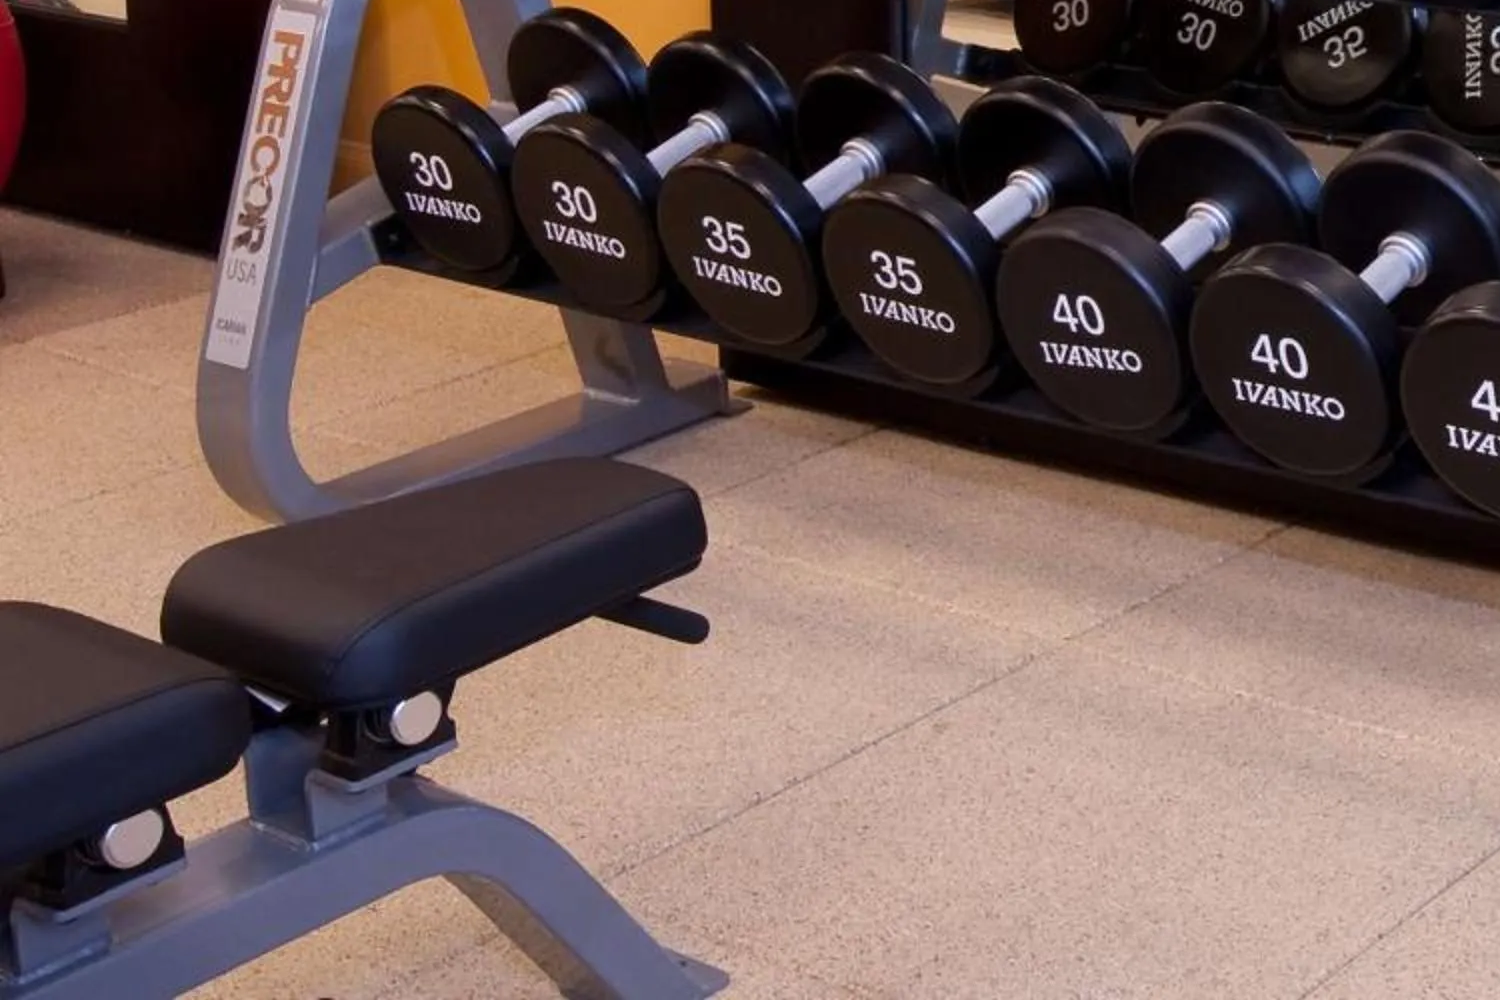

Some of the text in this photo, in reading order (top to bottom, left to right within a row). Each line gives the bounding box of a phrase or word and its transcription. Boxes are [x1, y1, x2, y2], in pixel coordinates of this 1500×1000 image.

[231, 29, 306, 255] PRECOR
[409, 151, 453, 191] 30
[405, 191, 482, 224] IVANKO
[551, 180, 597, 223] 30
[543, 220, 626, 259] IVANKO
[702, 215, 751, 260] 35
[225, 258, 258, 287] USA
[692, 256, 783, 297] IVANKO
[870, 250, 923, 296] 35
[859, 292, 956, 334] IVANKO
[1053, 293, 1105, 336] 40
[1039, 341, 1143, 373] IVANKO
[1250, 333, 1309, 380] 40
[1231, 377, 1345, 421] IVANKO
